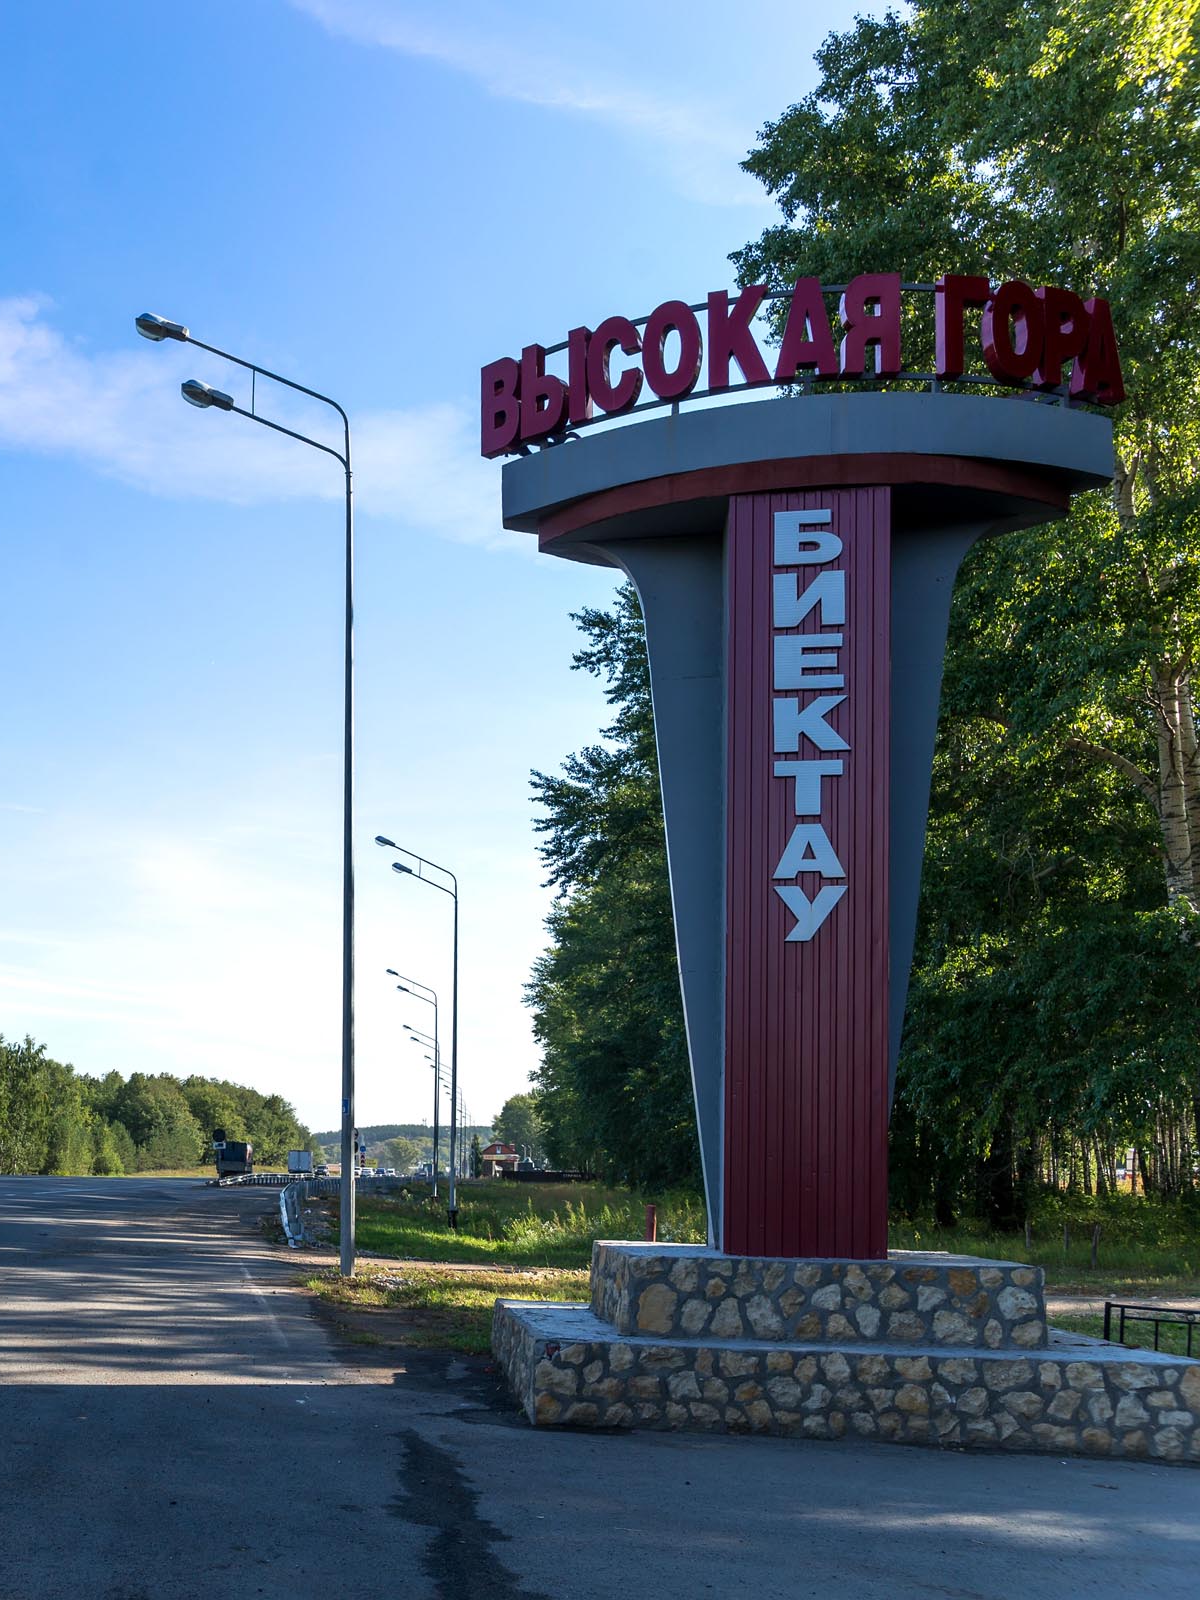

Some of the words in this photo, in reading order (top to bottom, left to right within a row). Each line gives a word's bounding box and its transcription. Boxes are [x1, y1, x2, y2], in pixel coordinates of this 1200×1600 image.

[481, 272, 900, 459] ВЫСОКАЯ
[935, 274, 1125, 406] ГОРА
[772, 508, 851, 942] БИЕКТАУ
